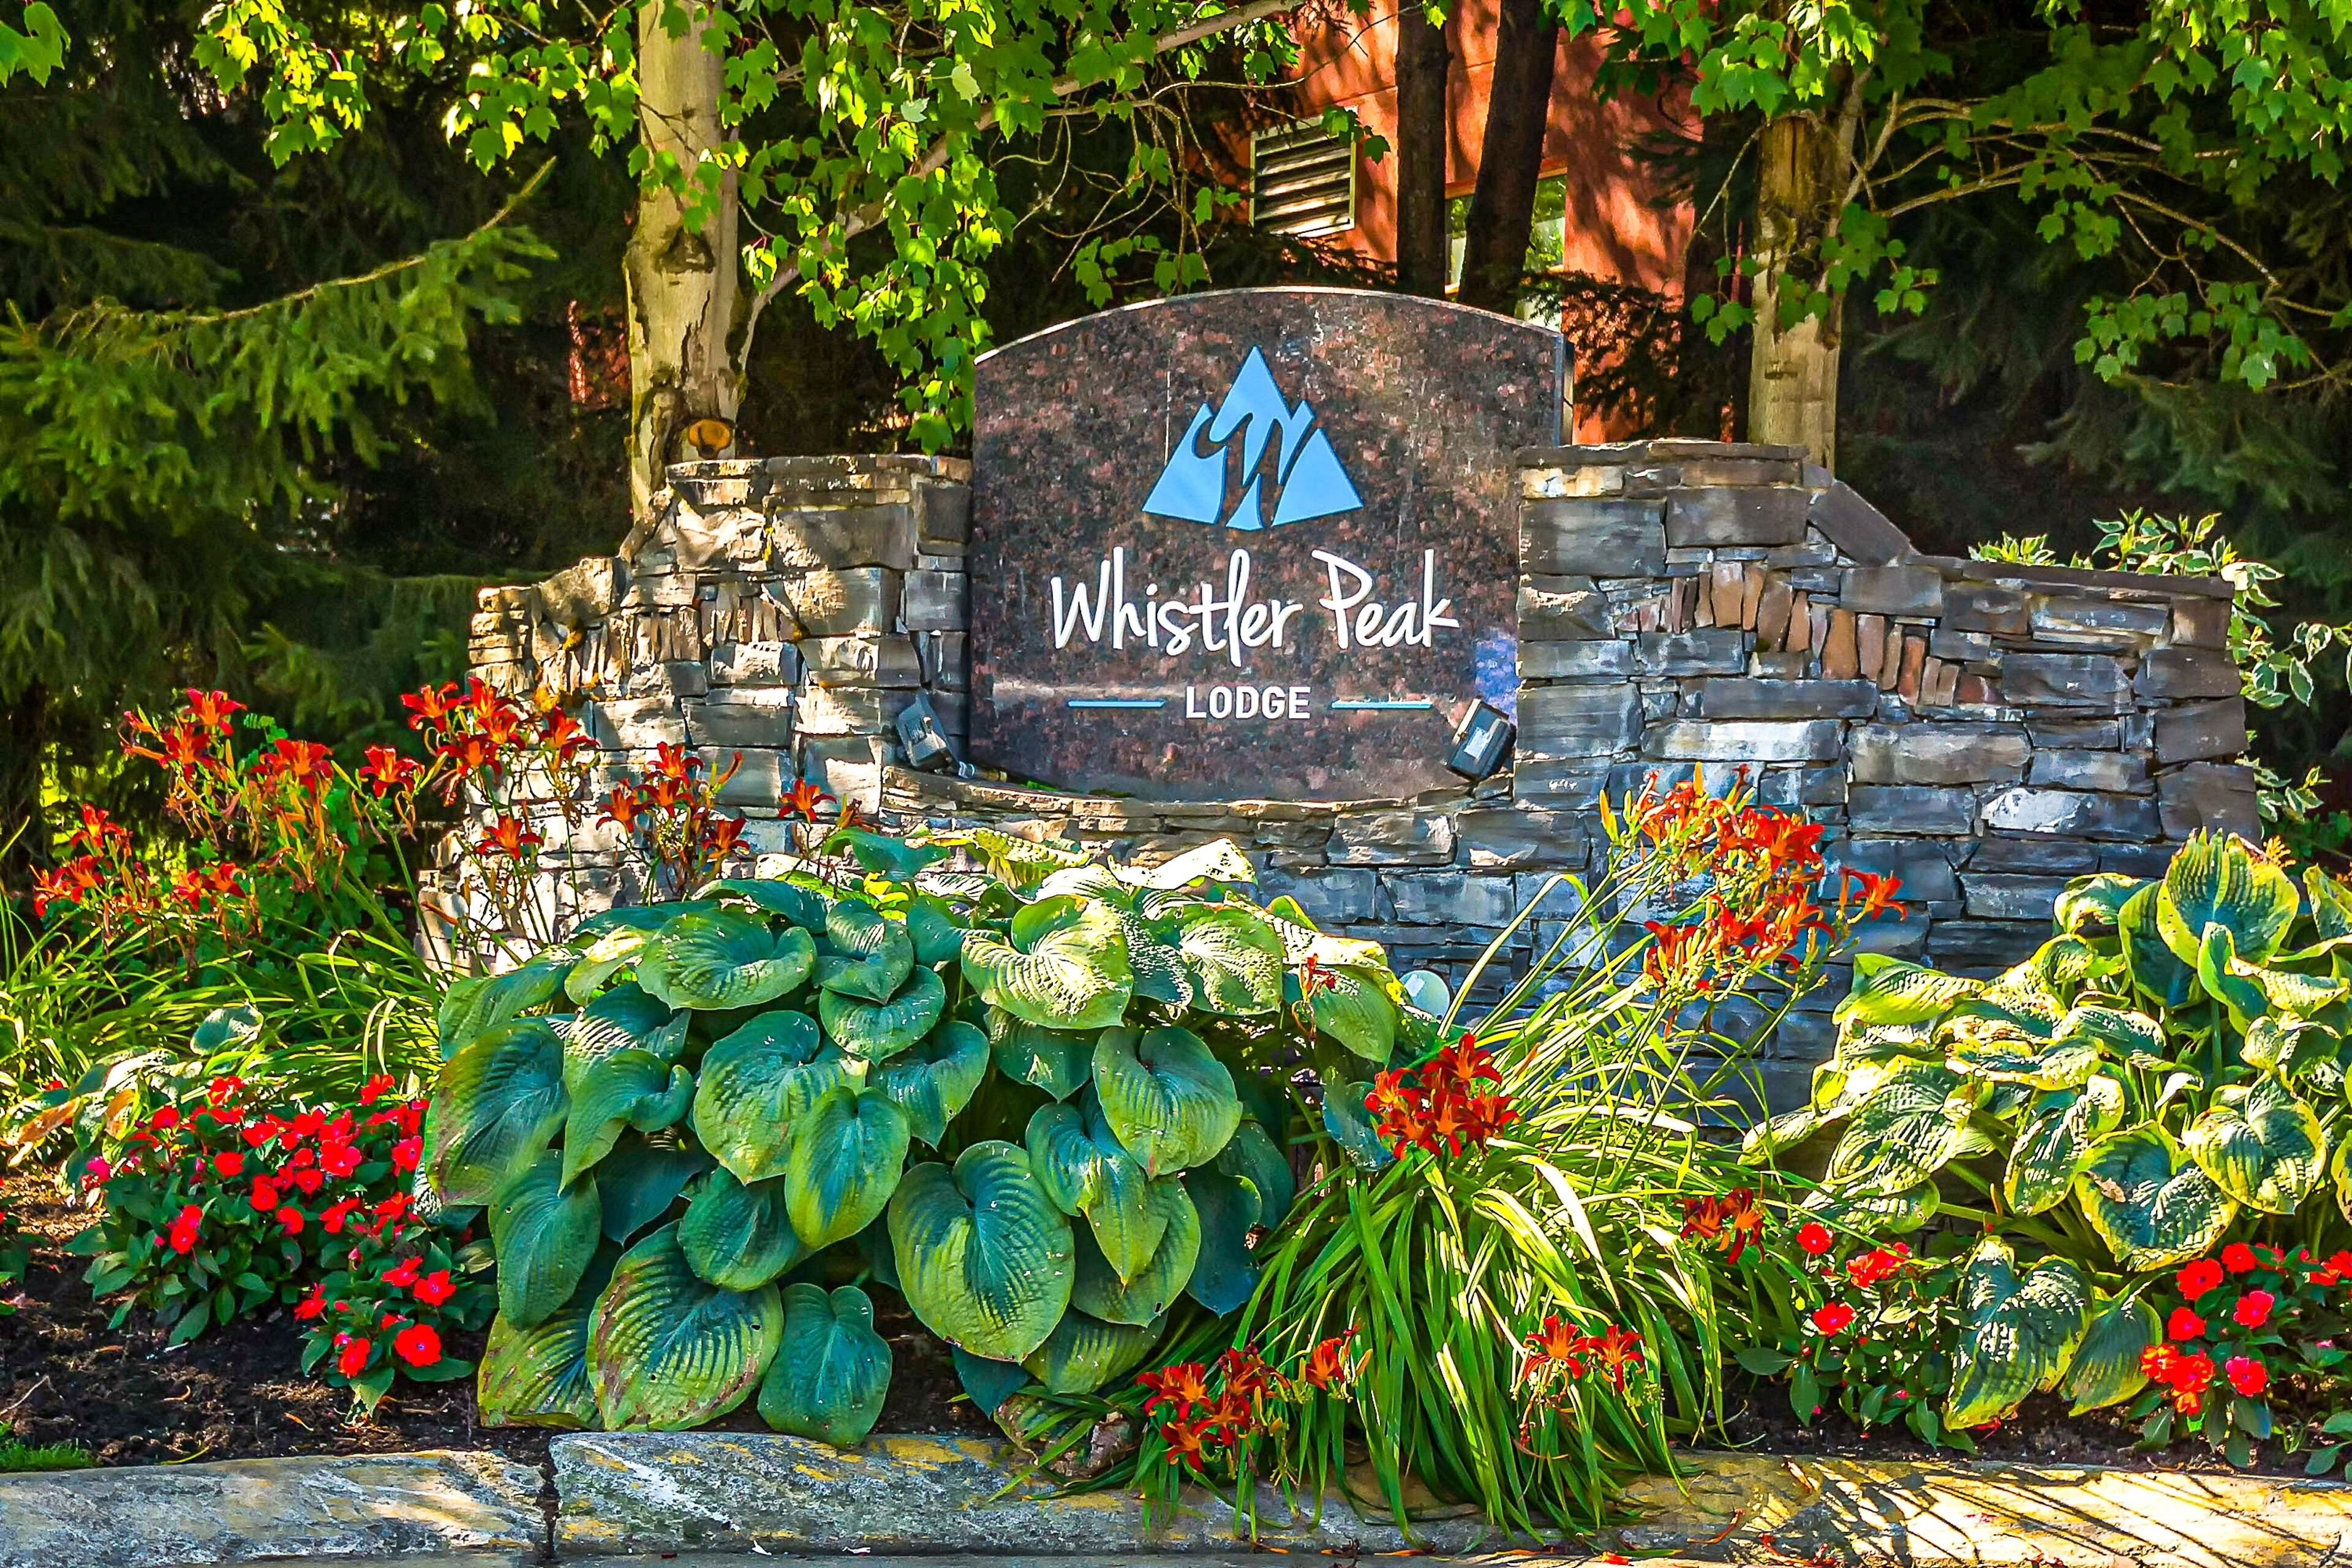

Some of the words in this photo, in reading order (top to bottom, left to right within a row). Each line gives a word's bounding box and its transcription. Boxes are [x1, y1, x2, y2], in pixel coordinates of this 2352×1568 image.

[1050, 546, 1304, 668] Whistler
[1311, 549, 1460, 649] Peak
[1185, 686, 1312, 720] LODGE
